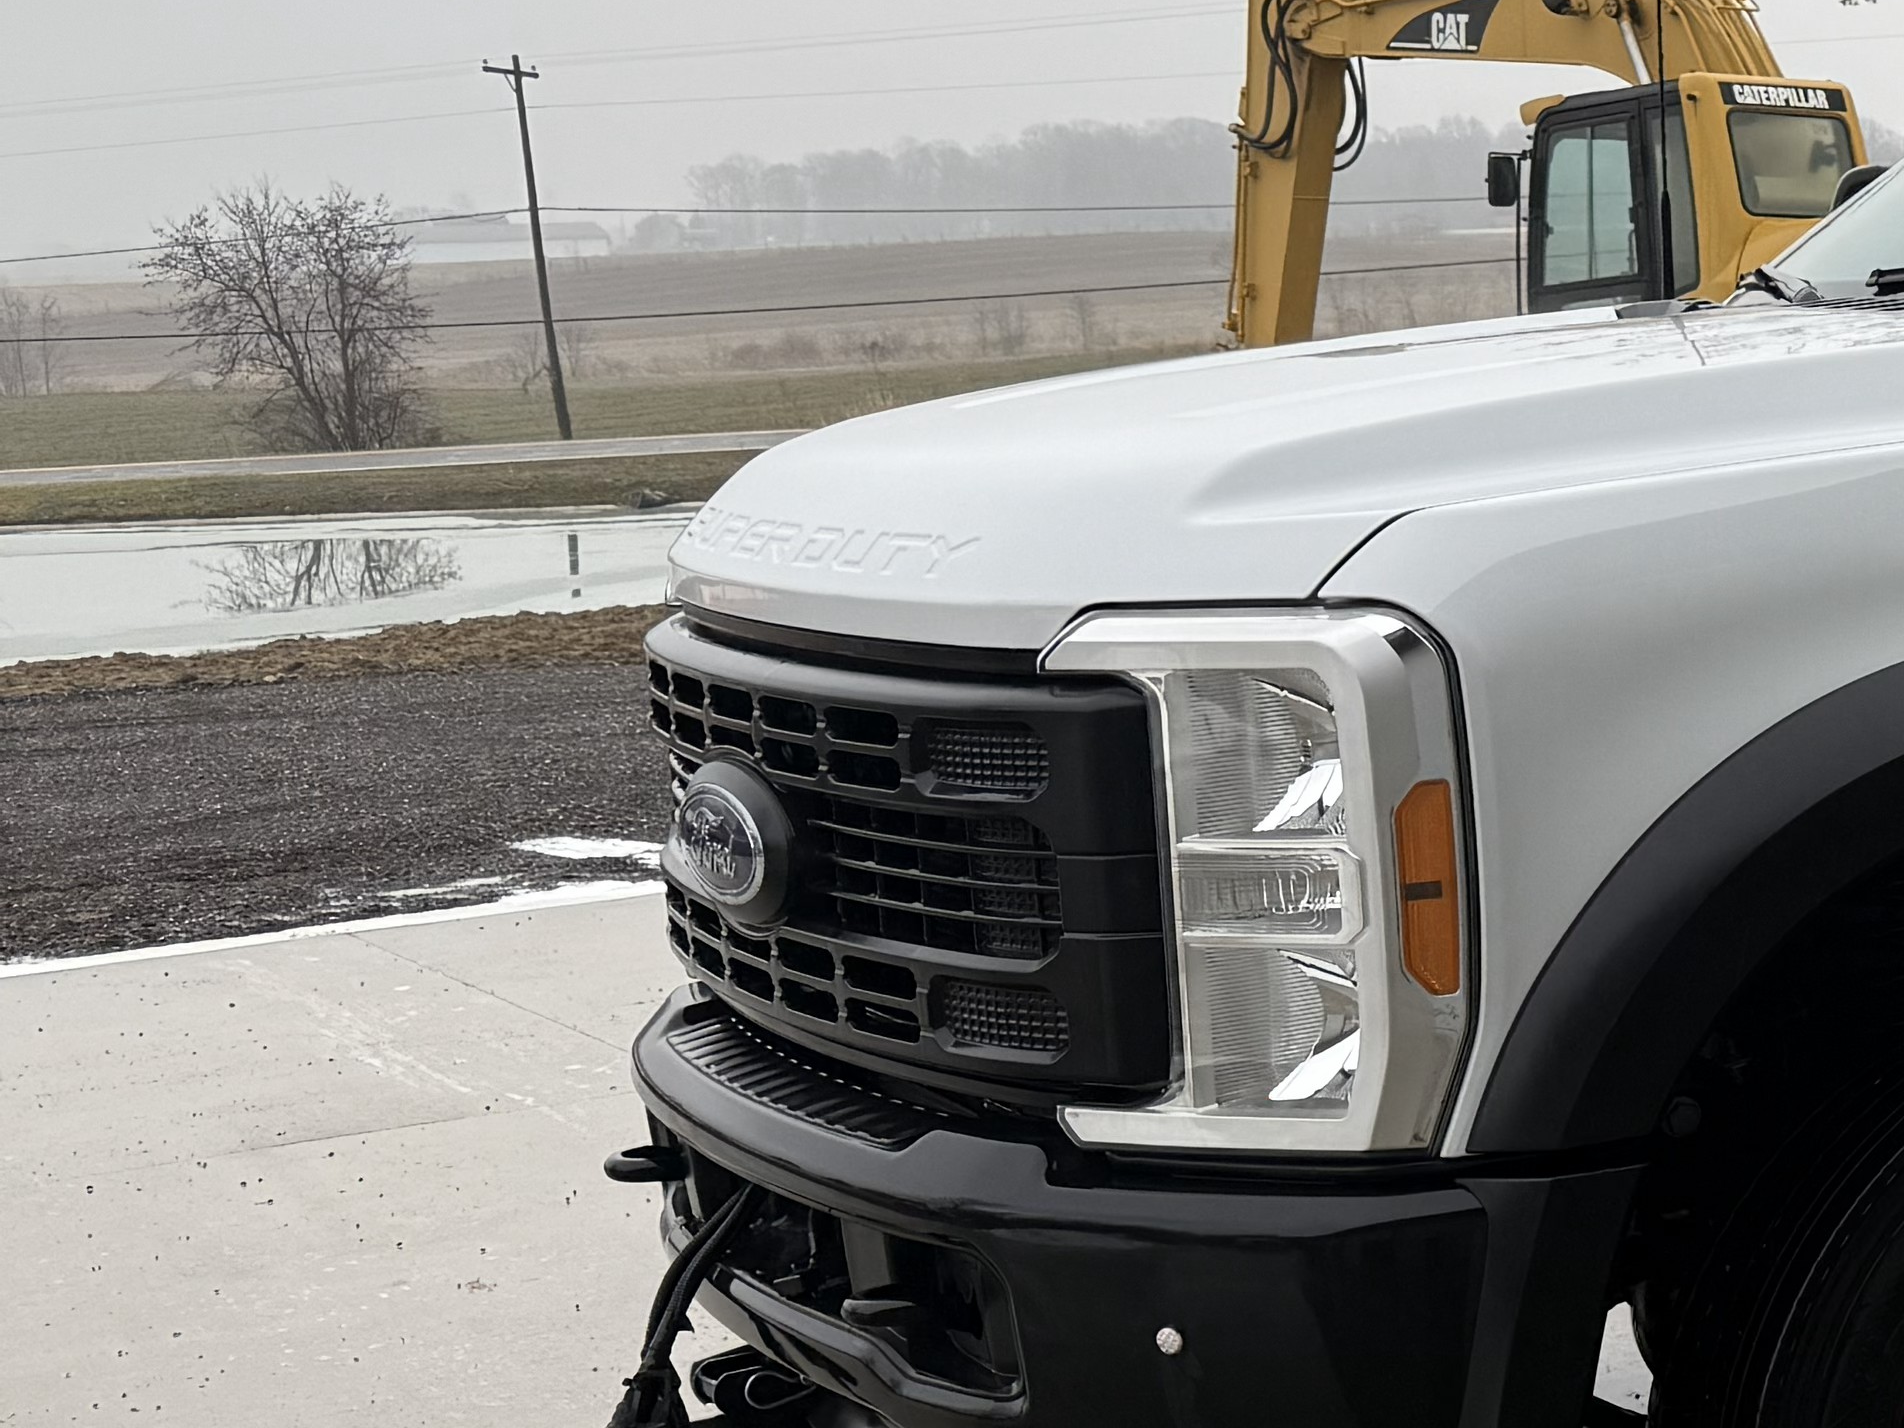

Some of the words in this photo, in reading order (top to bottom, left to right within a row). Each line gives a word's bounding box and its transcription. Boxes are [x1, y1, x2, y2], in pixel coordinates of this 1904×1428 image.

[1431, 12, 1469, 50] CAT
[1732, 84, 1829, 109] CATERPILLAR
[790, 526, 982, 579] DUTY
